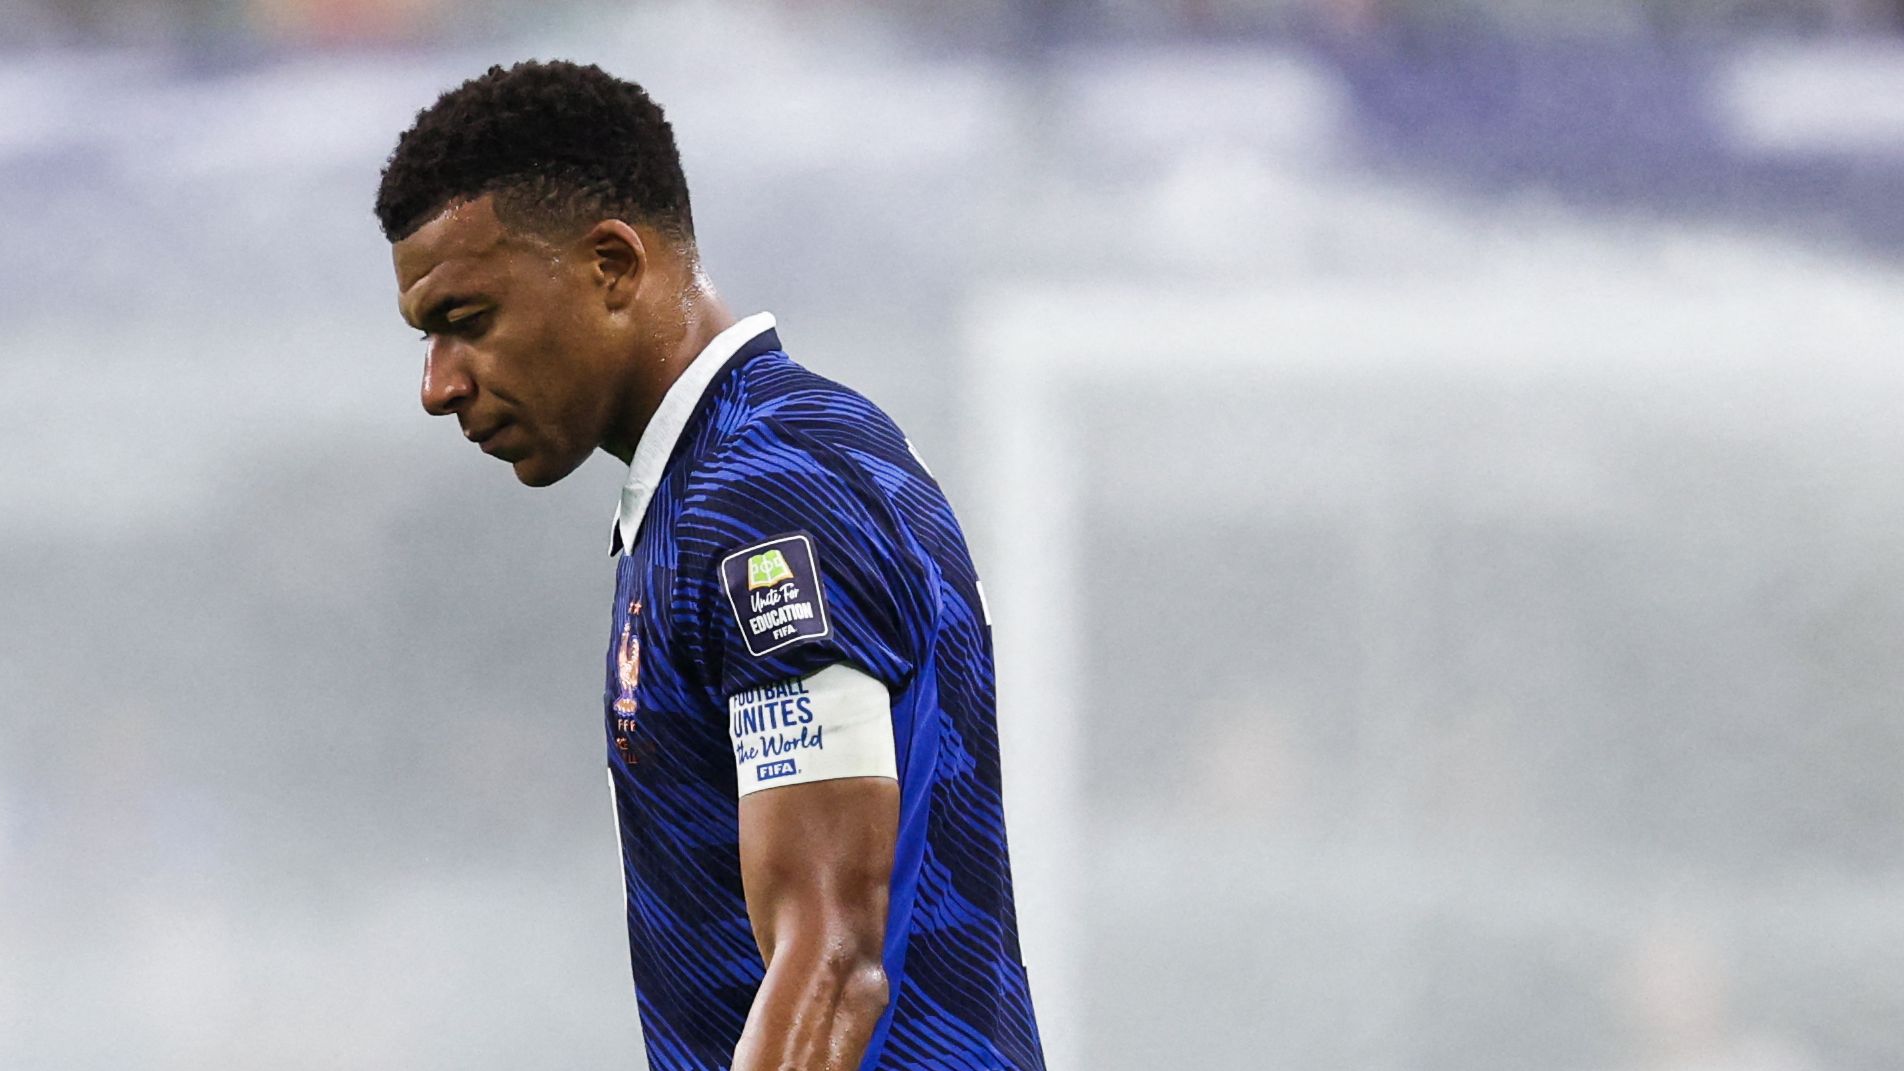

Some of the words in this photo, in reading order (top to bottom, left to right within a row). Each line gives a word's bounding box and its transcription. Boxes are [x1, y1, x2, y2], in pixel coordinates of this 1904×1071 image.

[750, 588, 781, 613] Unite
[779, 582, 799, 602] For
[749, 601, 814, 635] EDUCATION
[772, 624, 796, 640] FIFA
[734, 696, 813, 738] UNITES
[736, 740, 759, 765] the
[760, 725, 823, 758] World
[759, 762, 794, 778] FIFA
